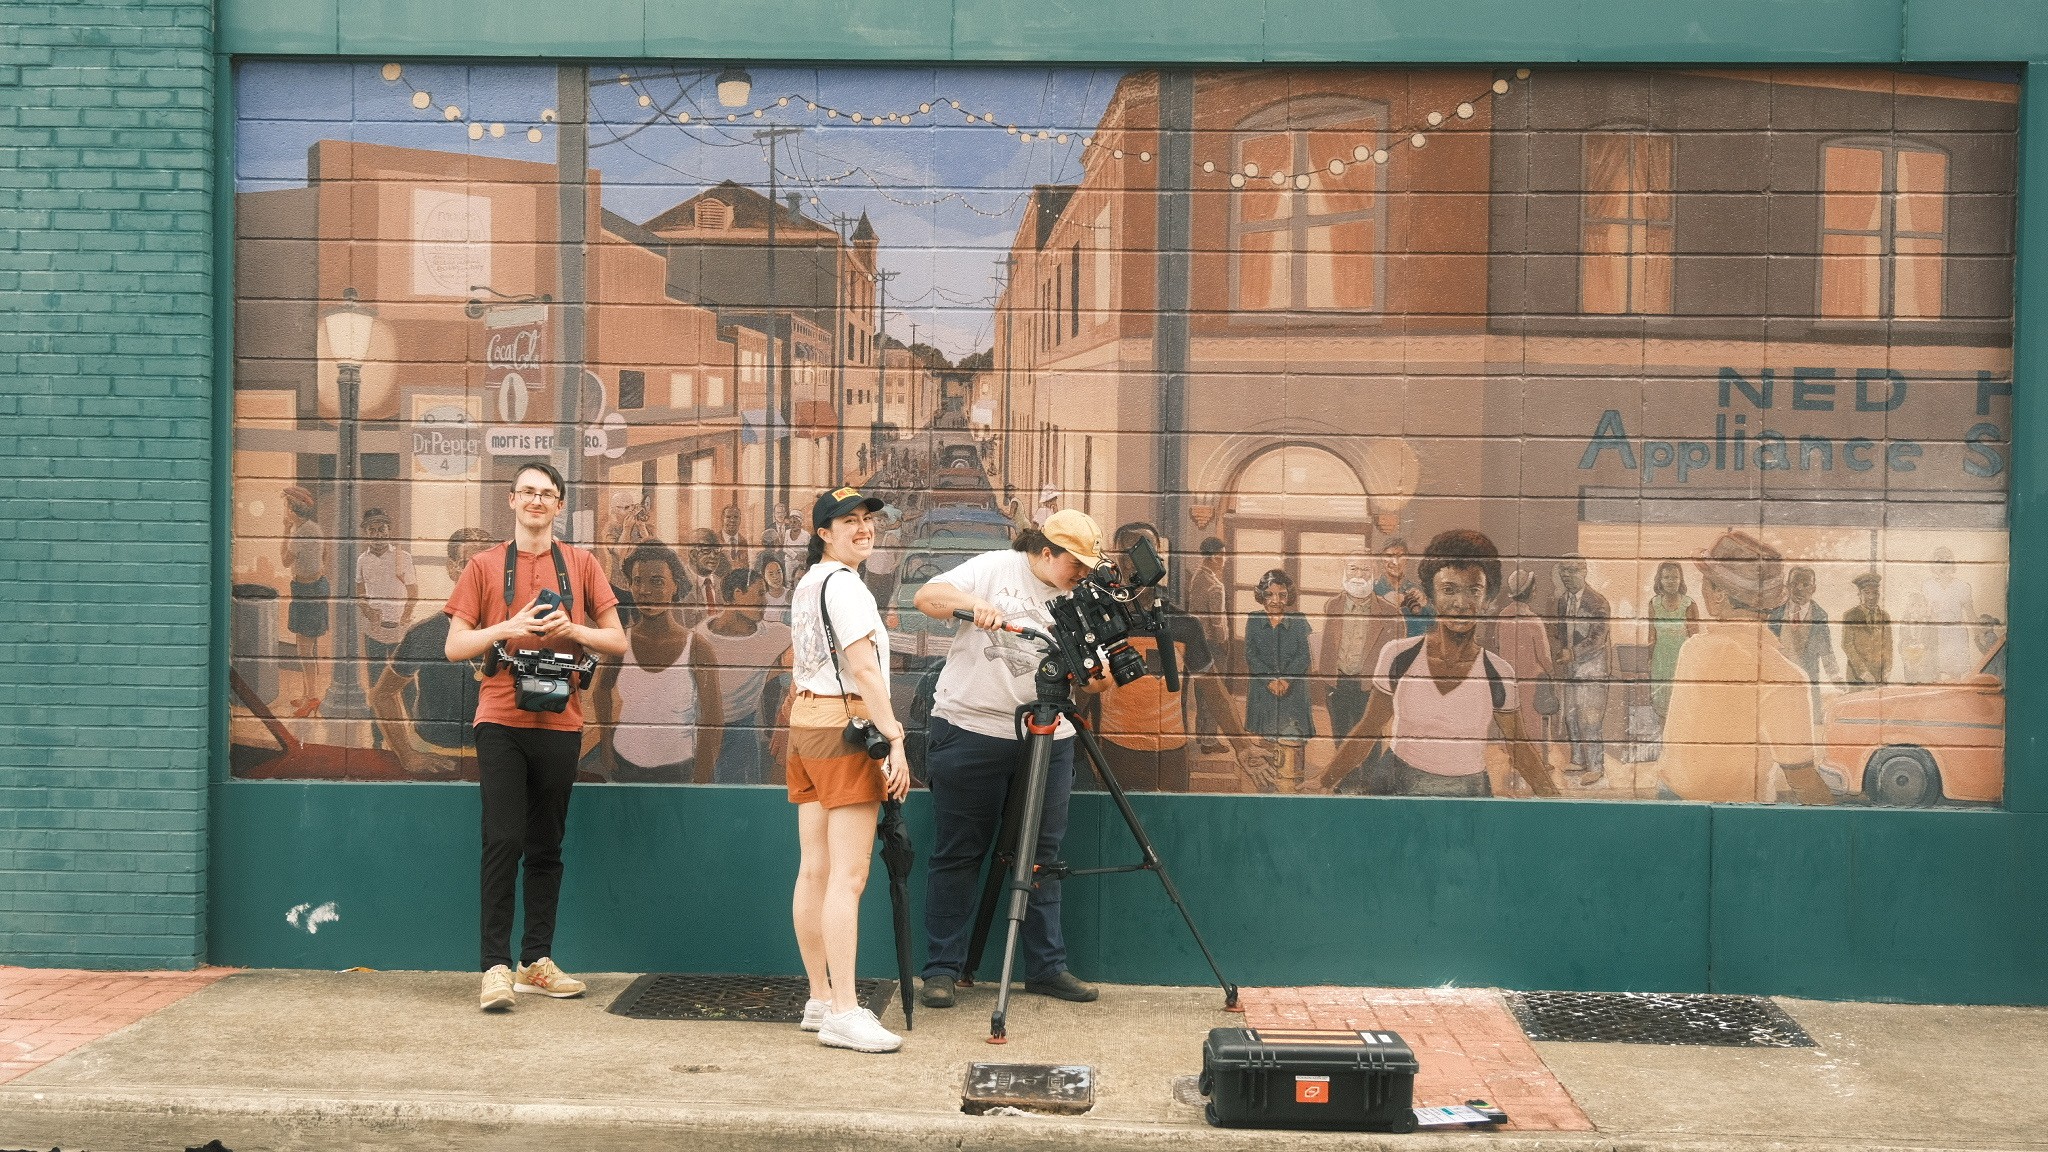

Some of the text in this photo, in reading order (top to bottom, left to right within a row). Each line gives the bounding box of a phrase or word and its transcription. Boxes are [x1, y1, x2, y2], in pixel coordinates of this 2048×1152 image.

[1718, 366, 1908, 413] NED
[440, 458, 450, 471] 4
[1578, 410, 2004, 483] Appliance S
